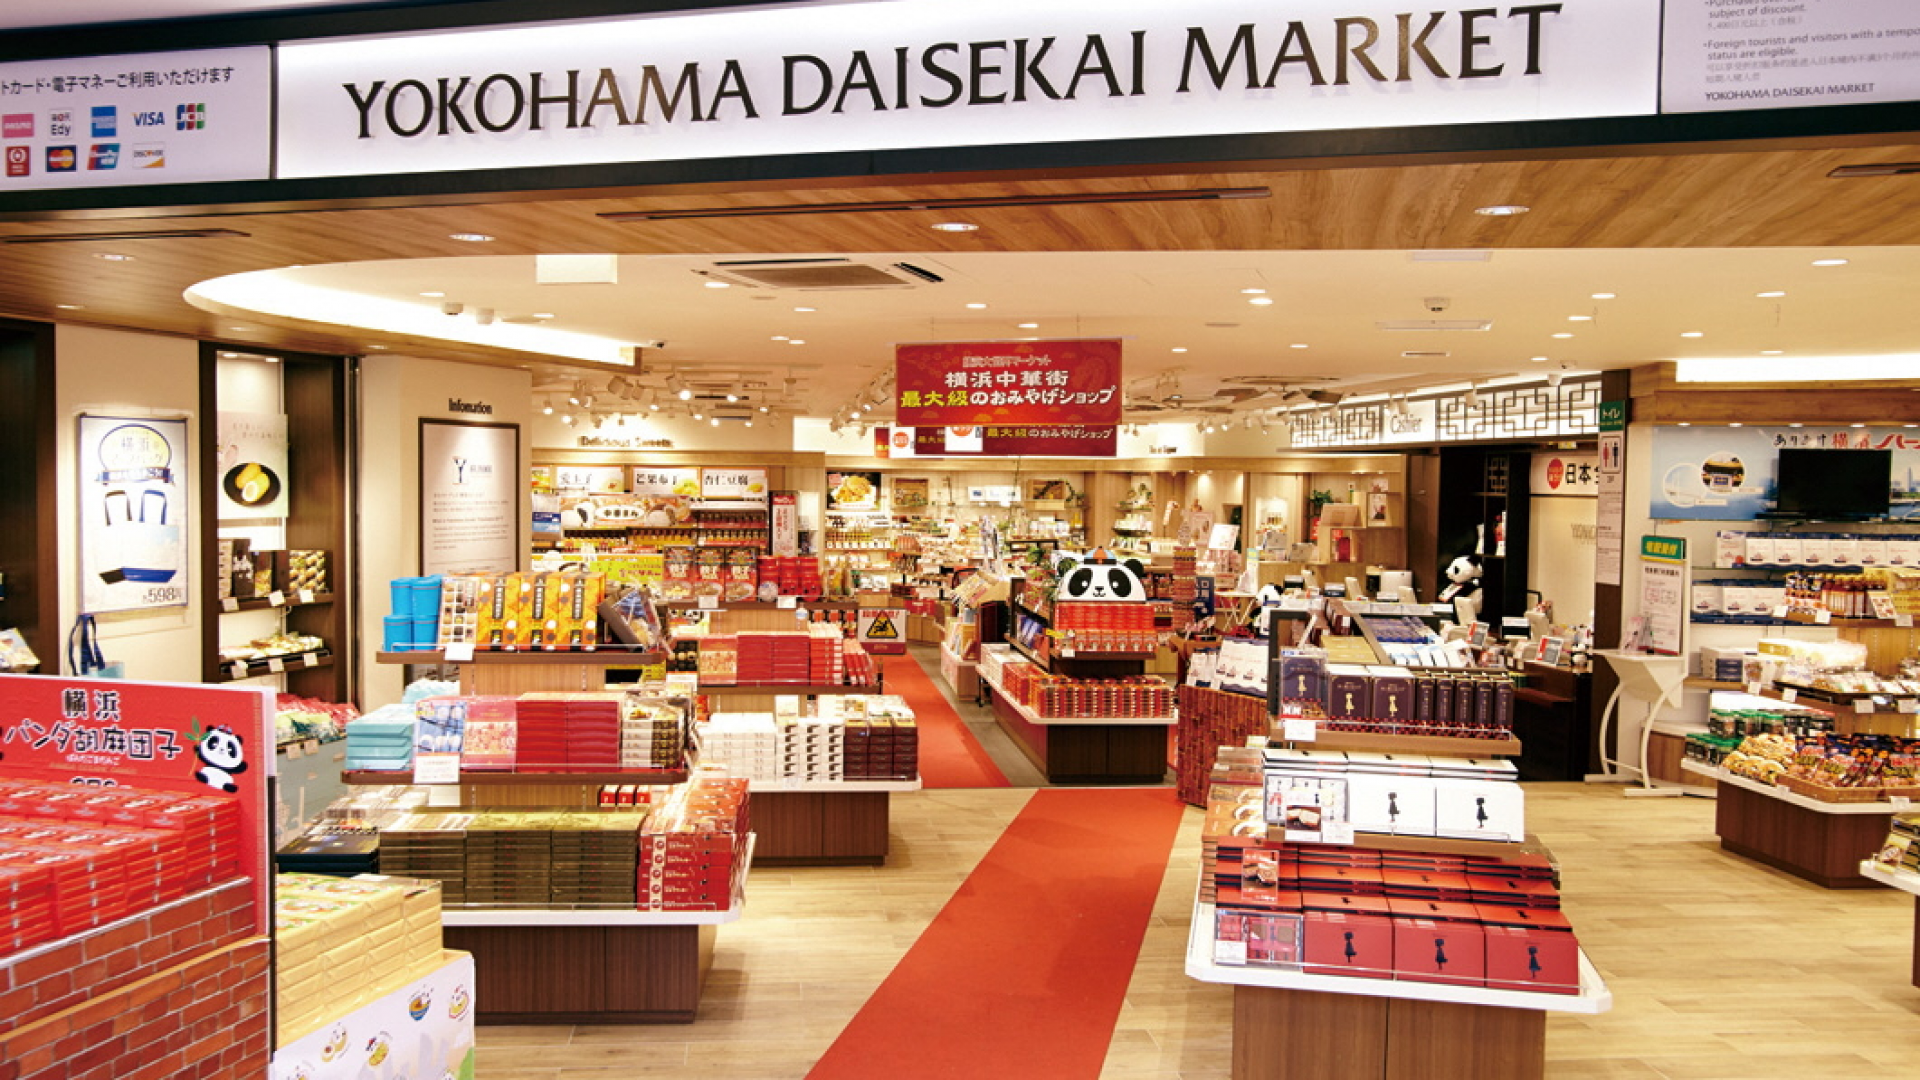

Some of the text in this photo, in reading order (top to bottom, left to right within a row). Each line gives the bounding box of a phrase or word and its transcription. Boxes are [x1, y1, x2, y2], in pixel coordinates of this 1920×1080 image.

[1709, 9, 1745, 20] subject
[1747, 7, 1758, 16] of
[1748, 36, 1786, 46] tourists
[1789, 34, 1808, 43] and
[1811, 31, 1848, 42] visitors
[1850, 29, 1873, 39] with
[1707, 50, 1737, 61] status
[1739, 50, 1755, 58] are
[343, 3, 1562, 138] YOKOHAMA DAISEKAI MARKET
[1705, 82, 1875, 101] YOKOHAMA DAISEKAI MARKET
[133, 111, 165, 127] VISA
[51, 124, 71, 137] Edy
[944, 370, 1069, 388] 横浜中華街
[901, 385, 1117, 408] 最大級のおみやげショップ
[986, 427, 1113, 438] 最大級のおみやげショップ
[578, 435, 674, 448] Delicious Sweets
[61, 688, 121, 720] 横浜
[3, 718, 184, 760] パンダ胡麻団子
